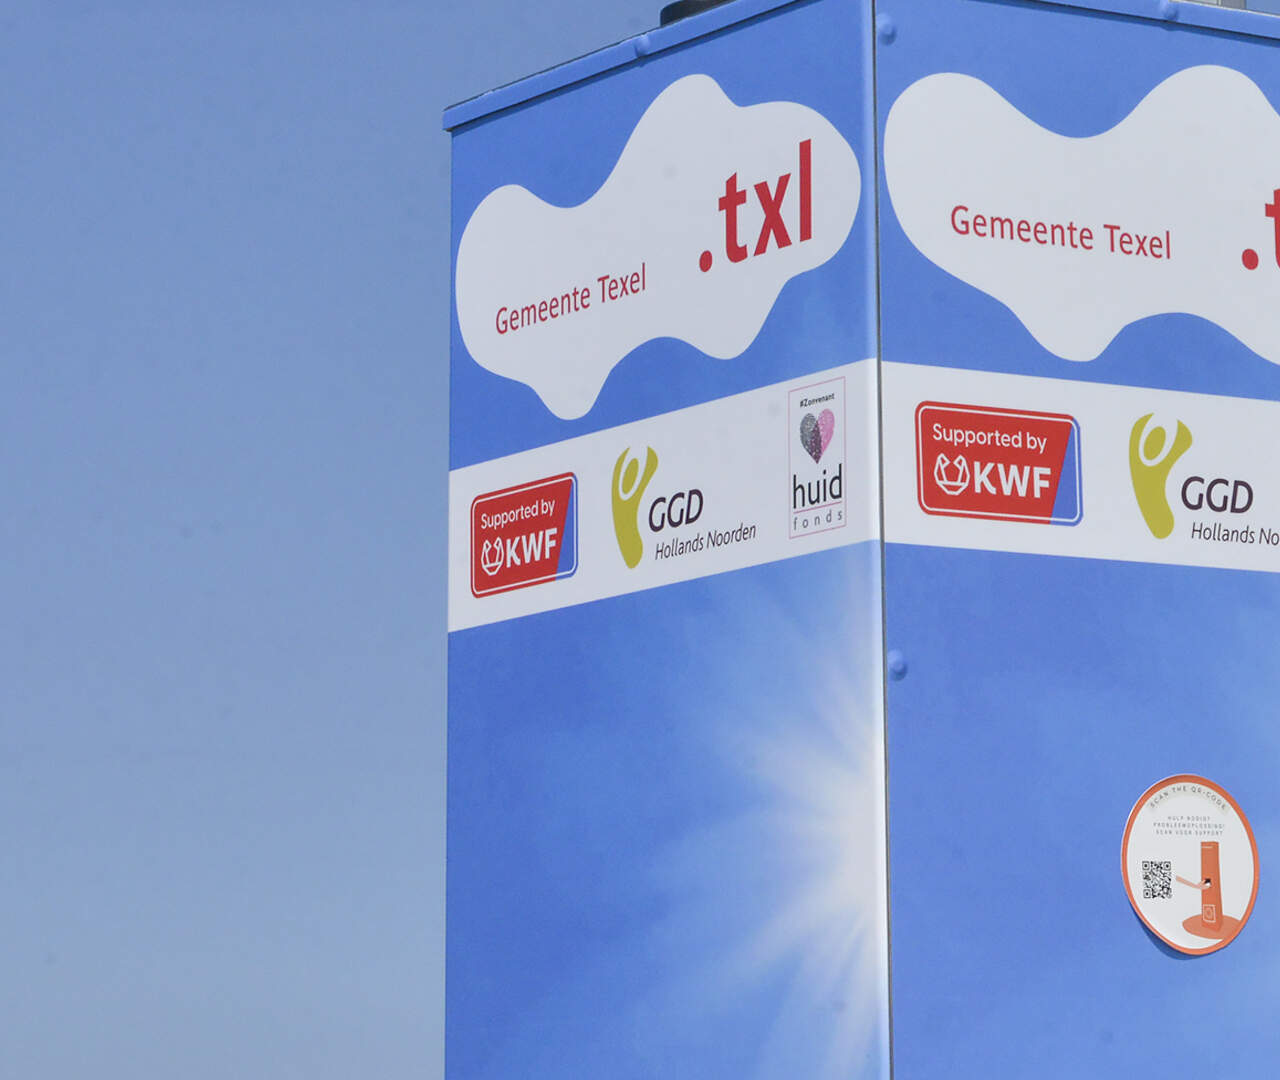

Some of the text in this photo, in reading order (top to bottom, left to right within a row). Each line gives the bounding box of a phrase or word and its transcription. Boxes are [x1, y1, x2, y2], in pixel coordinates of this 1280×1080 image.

[698, 138, 813, 273] .txl
[951, 205, 1172, 260] Gemeente Texel
[495, 263, 647, 335] Gemeente Texel
[932, 423, 1048, 454] Supported by
[792, 463, 843, 509] huid
[973, 461, 1052, 499] KWF
[1180, 475, 1254, 514] GGD
[480, 499, 556, 530] Supported by
[648, 488, 704, 533] GGD
[793, 509, 844, 530] fonds
[506, 527, 558, 566] KWF
[654, 522, 757, 560] Hollands Noorden
[1191, 521, 1256, 545] Hollands
